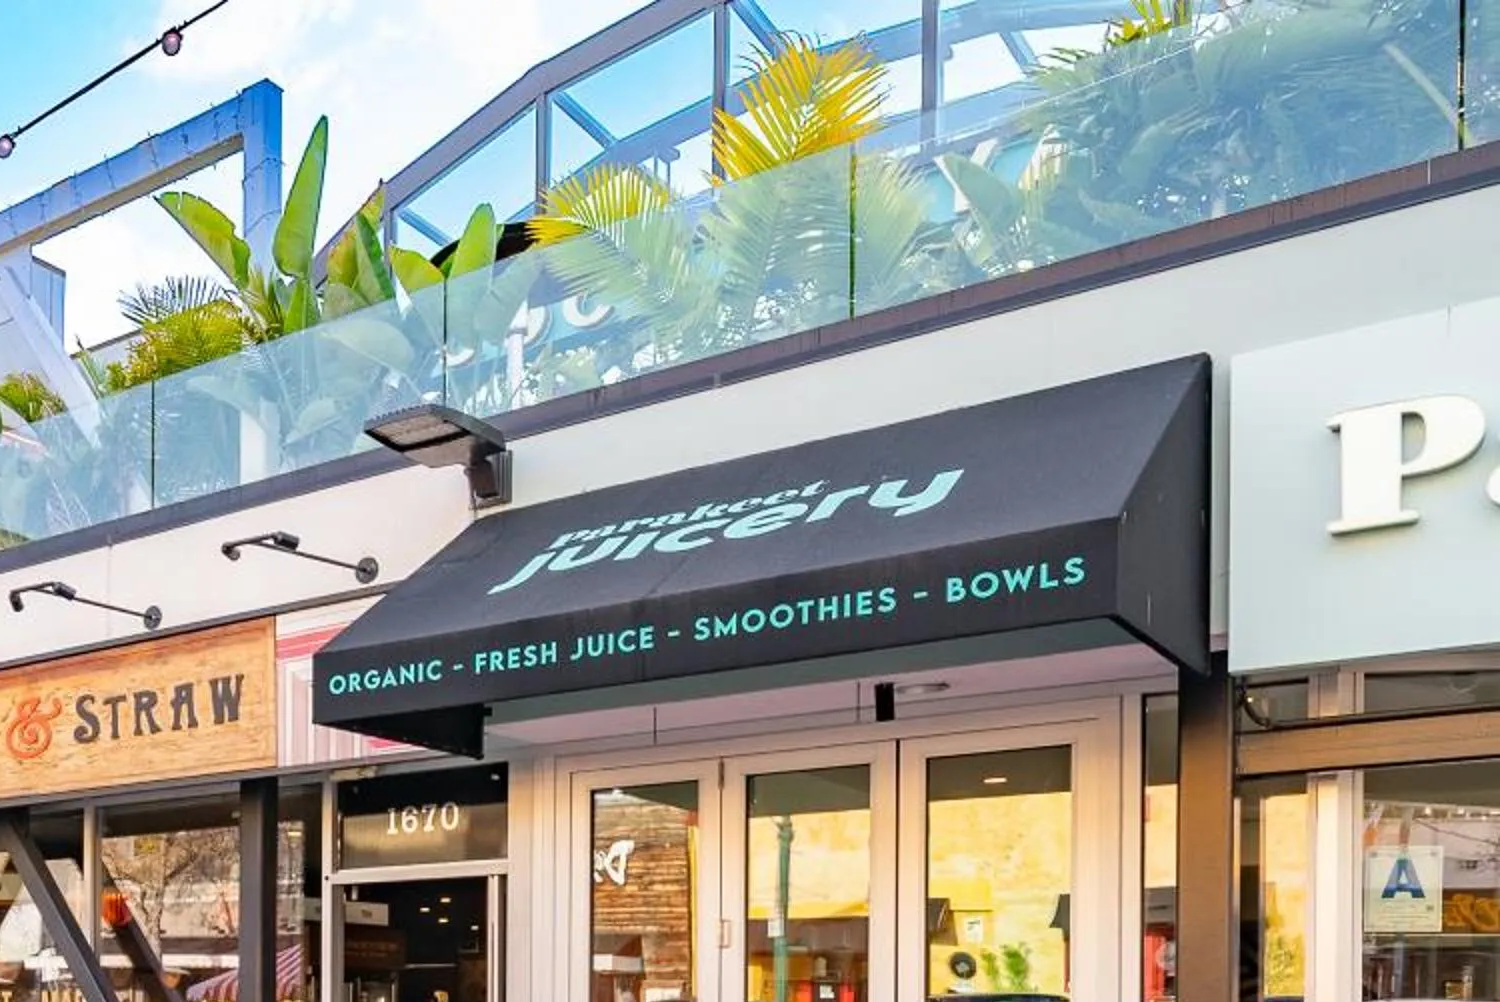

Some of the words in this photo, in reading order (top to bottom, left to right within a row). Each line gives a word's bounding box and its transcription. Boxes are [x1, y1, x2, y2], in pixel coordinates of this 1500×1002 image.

[1326, 394, 1500, 536] P
[329, 660, 443, 695] ORGANIC
[475, 642, 558, 674] FRESH
[570, 626, 655, 661] JUICE
[693, 587, 897, 641] SMOOTHIES
[946, 557, 1086, 603] BOWLS
[6, 697, 62, 759] &
[74, 674, 244, 744] STRAW
[387, 804, 459, 835] 1670
[1381, 858, 1426, 898] A
